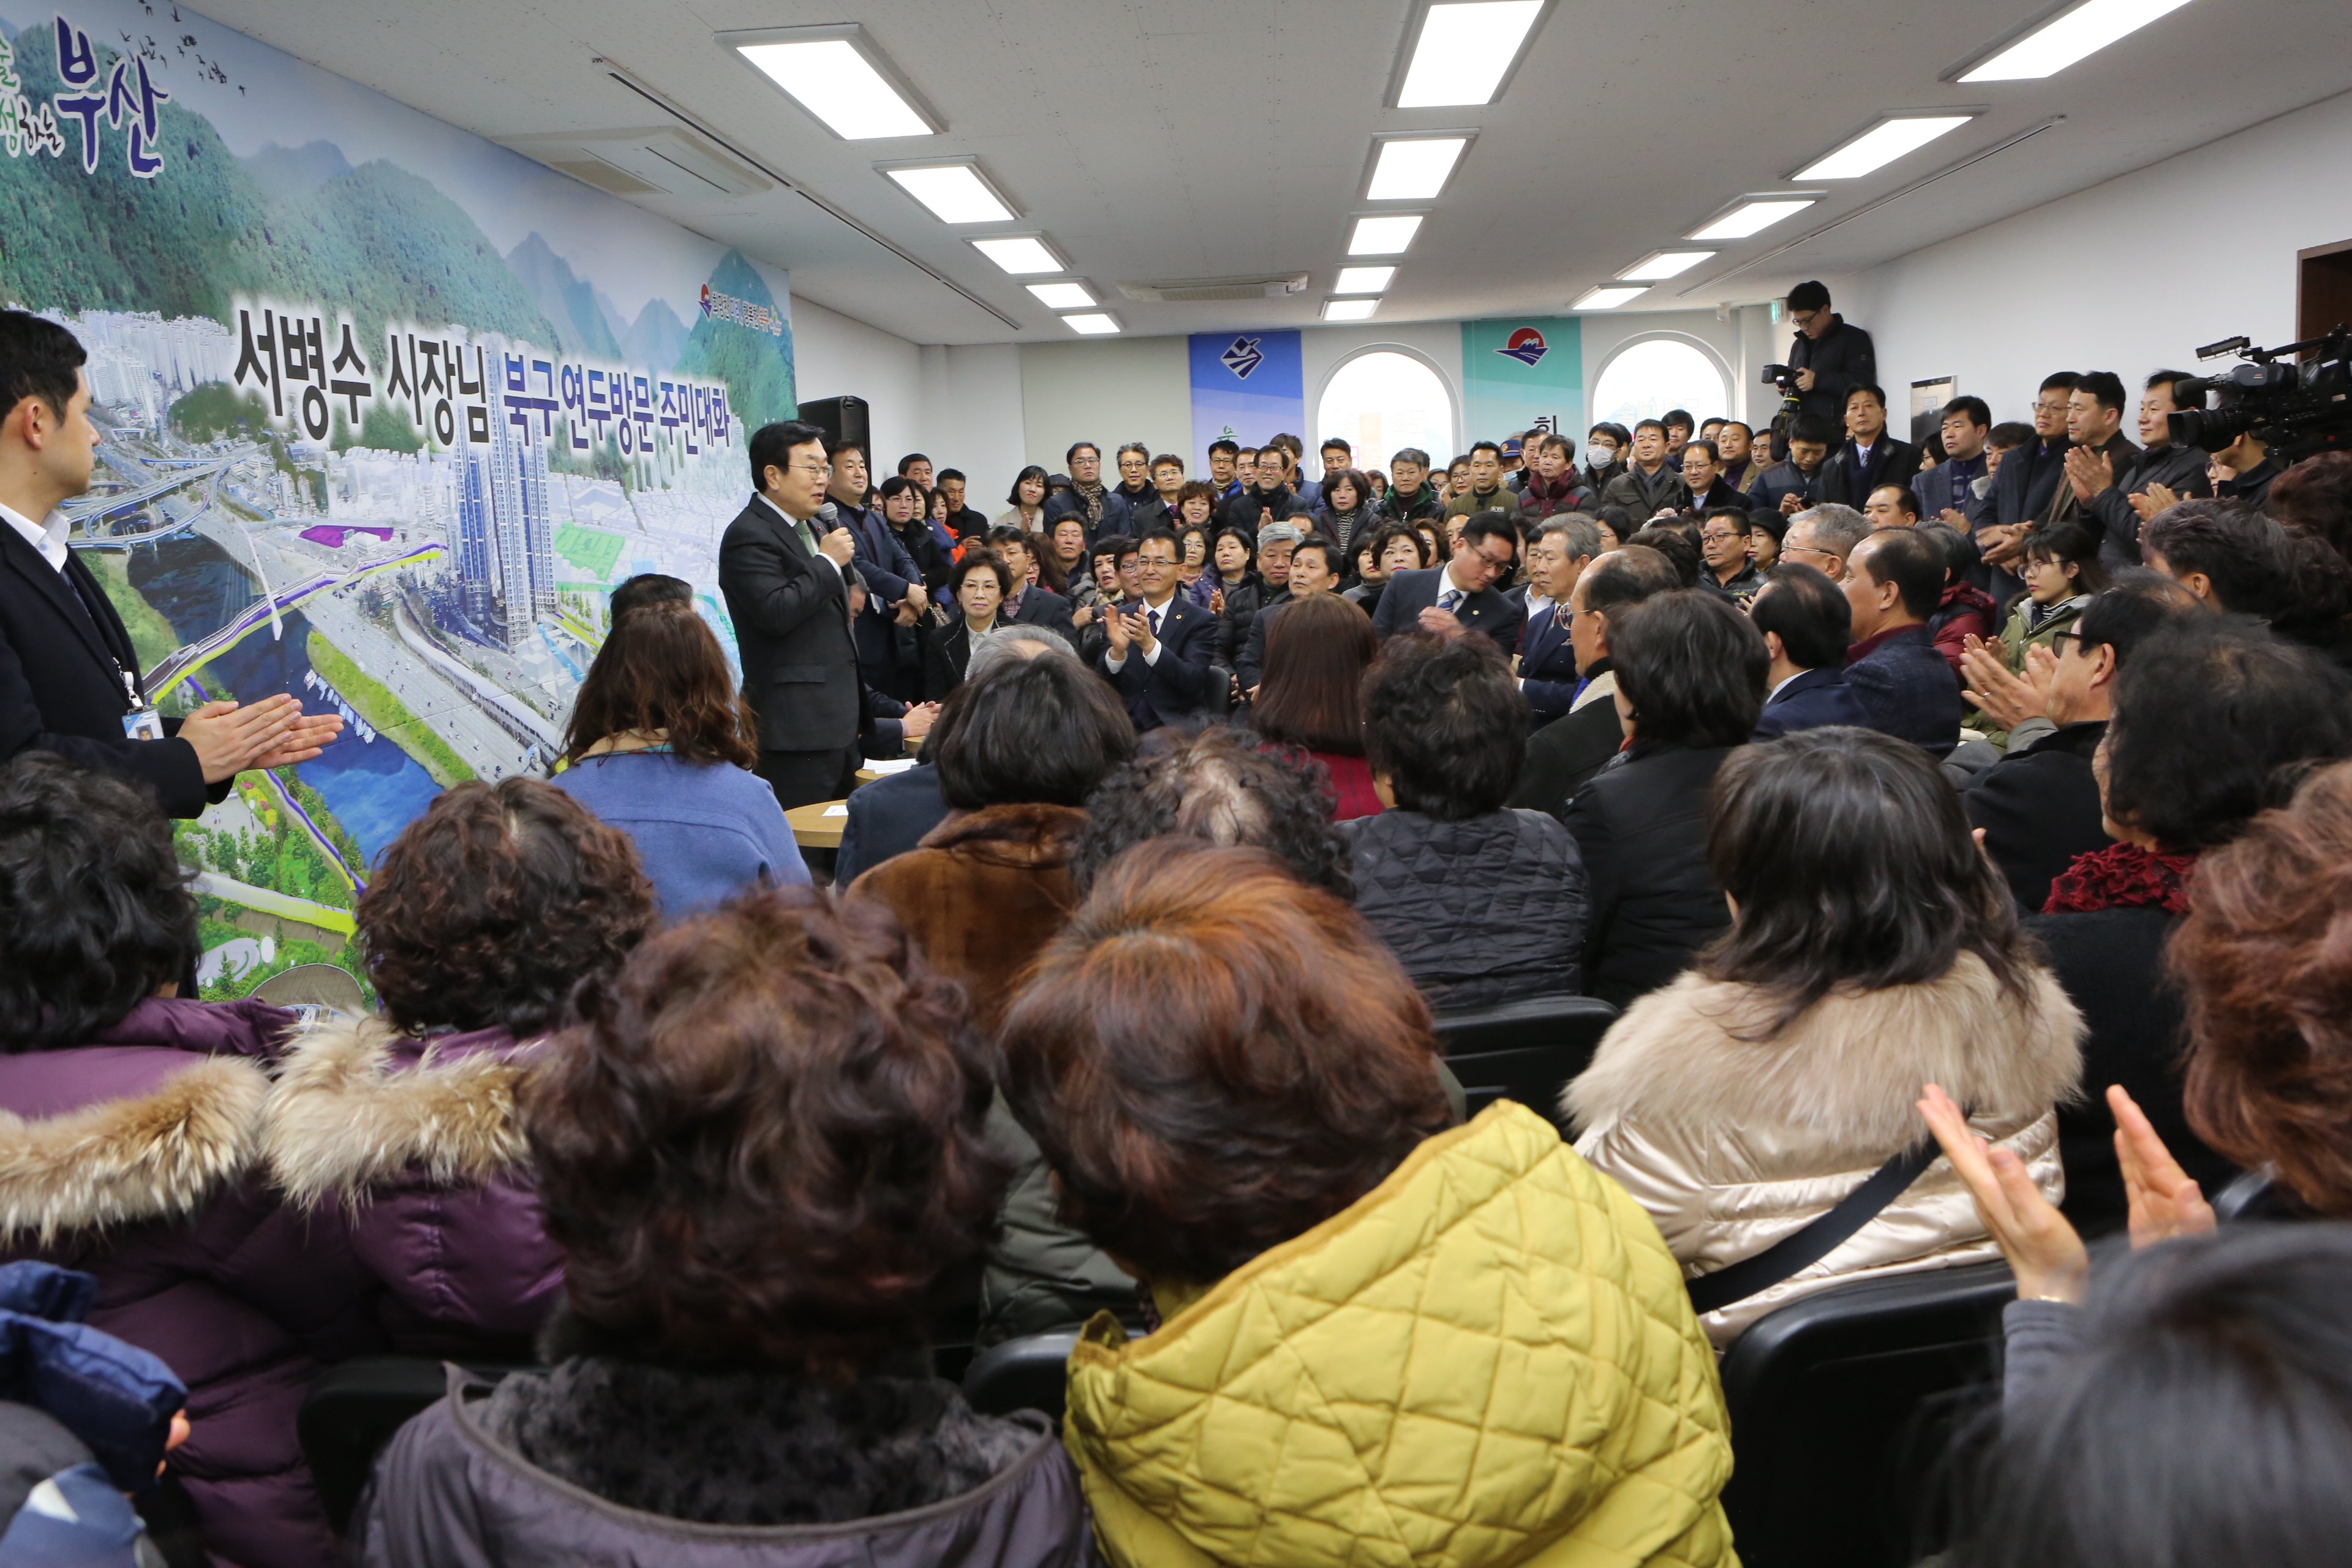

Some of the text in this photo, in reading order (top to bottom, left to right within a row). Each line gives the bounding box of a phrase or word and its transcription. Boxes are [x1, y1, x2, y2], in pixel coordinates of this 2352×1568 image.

[57, 16, 169, 173] 부산
[233, 309, 372, 441] 서병수
[387, 333, 489, 446] 시장님
